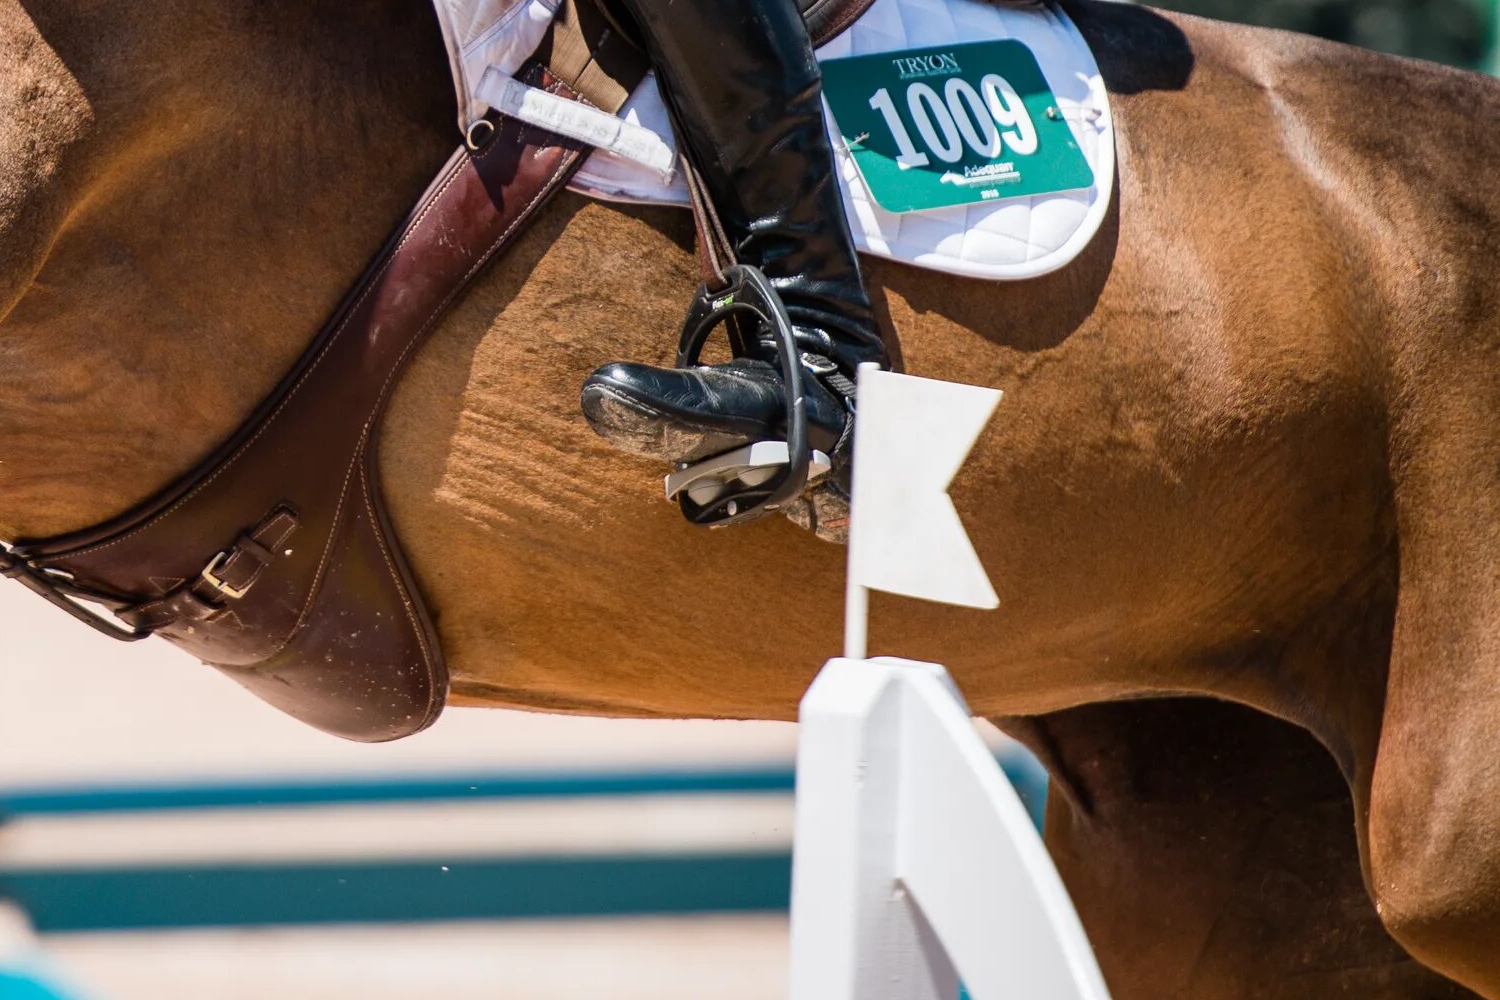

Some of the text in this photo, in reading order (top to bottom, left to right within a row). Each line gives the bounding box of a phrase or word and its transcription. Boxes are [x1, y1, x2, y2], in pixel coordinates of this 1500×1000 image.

[893, 52, 957, 74] TRYON
[868, 73, 1038, 170] 1009
[963, 161, 1014, 178] Adequan
